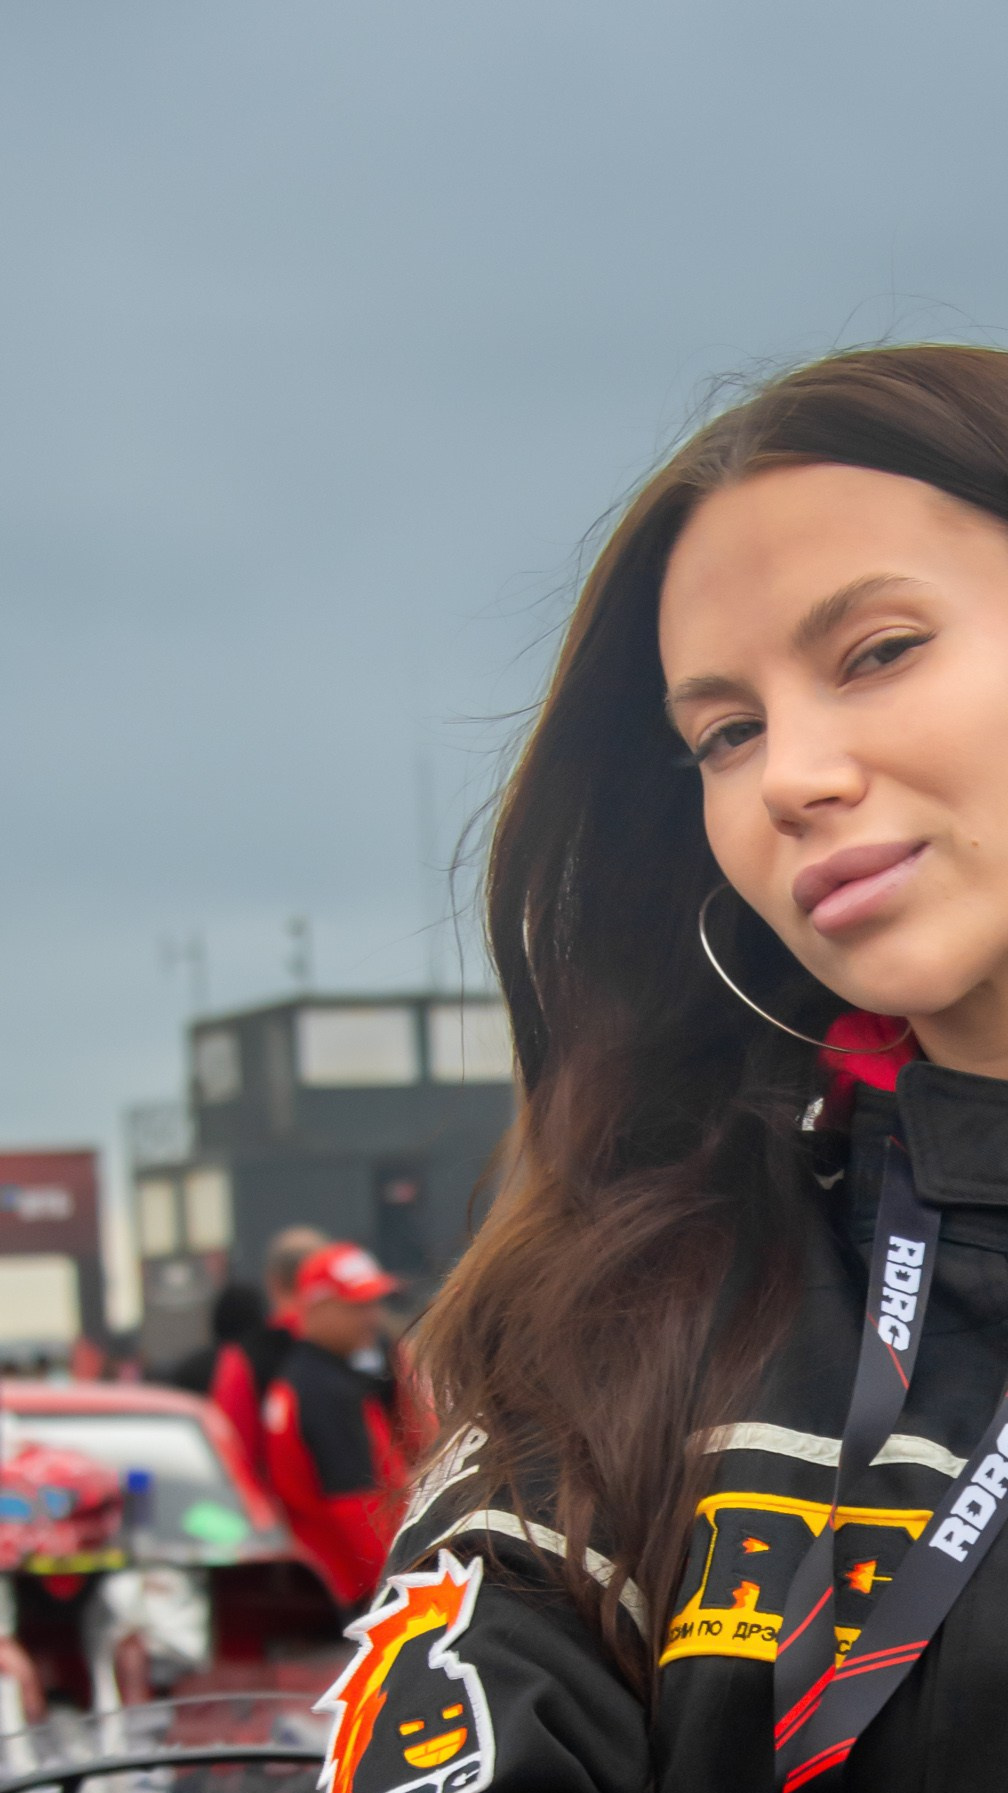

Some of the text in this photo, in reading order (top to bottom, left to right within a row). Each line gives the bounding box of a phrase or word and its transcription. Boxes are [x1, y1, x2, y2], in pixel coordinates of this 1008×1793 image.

[878, 1235, 925, 1351] RDRG
[697, 1620, 723, 1636] ПО
[732, 1621, 778, 1643] ДРЭ
